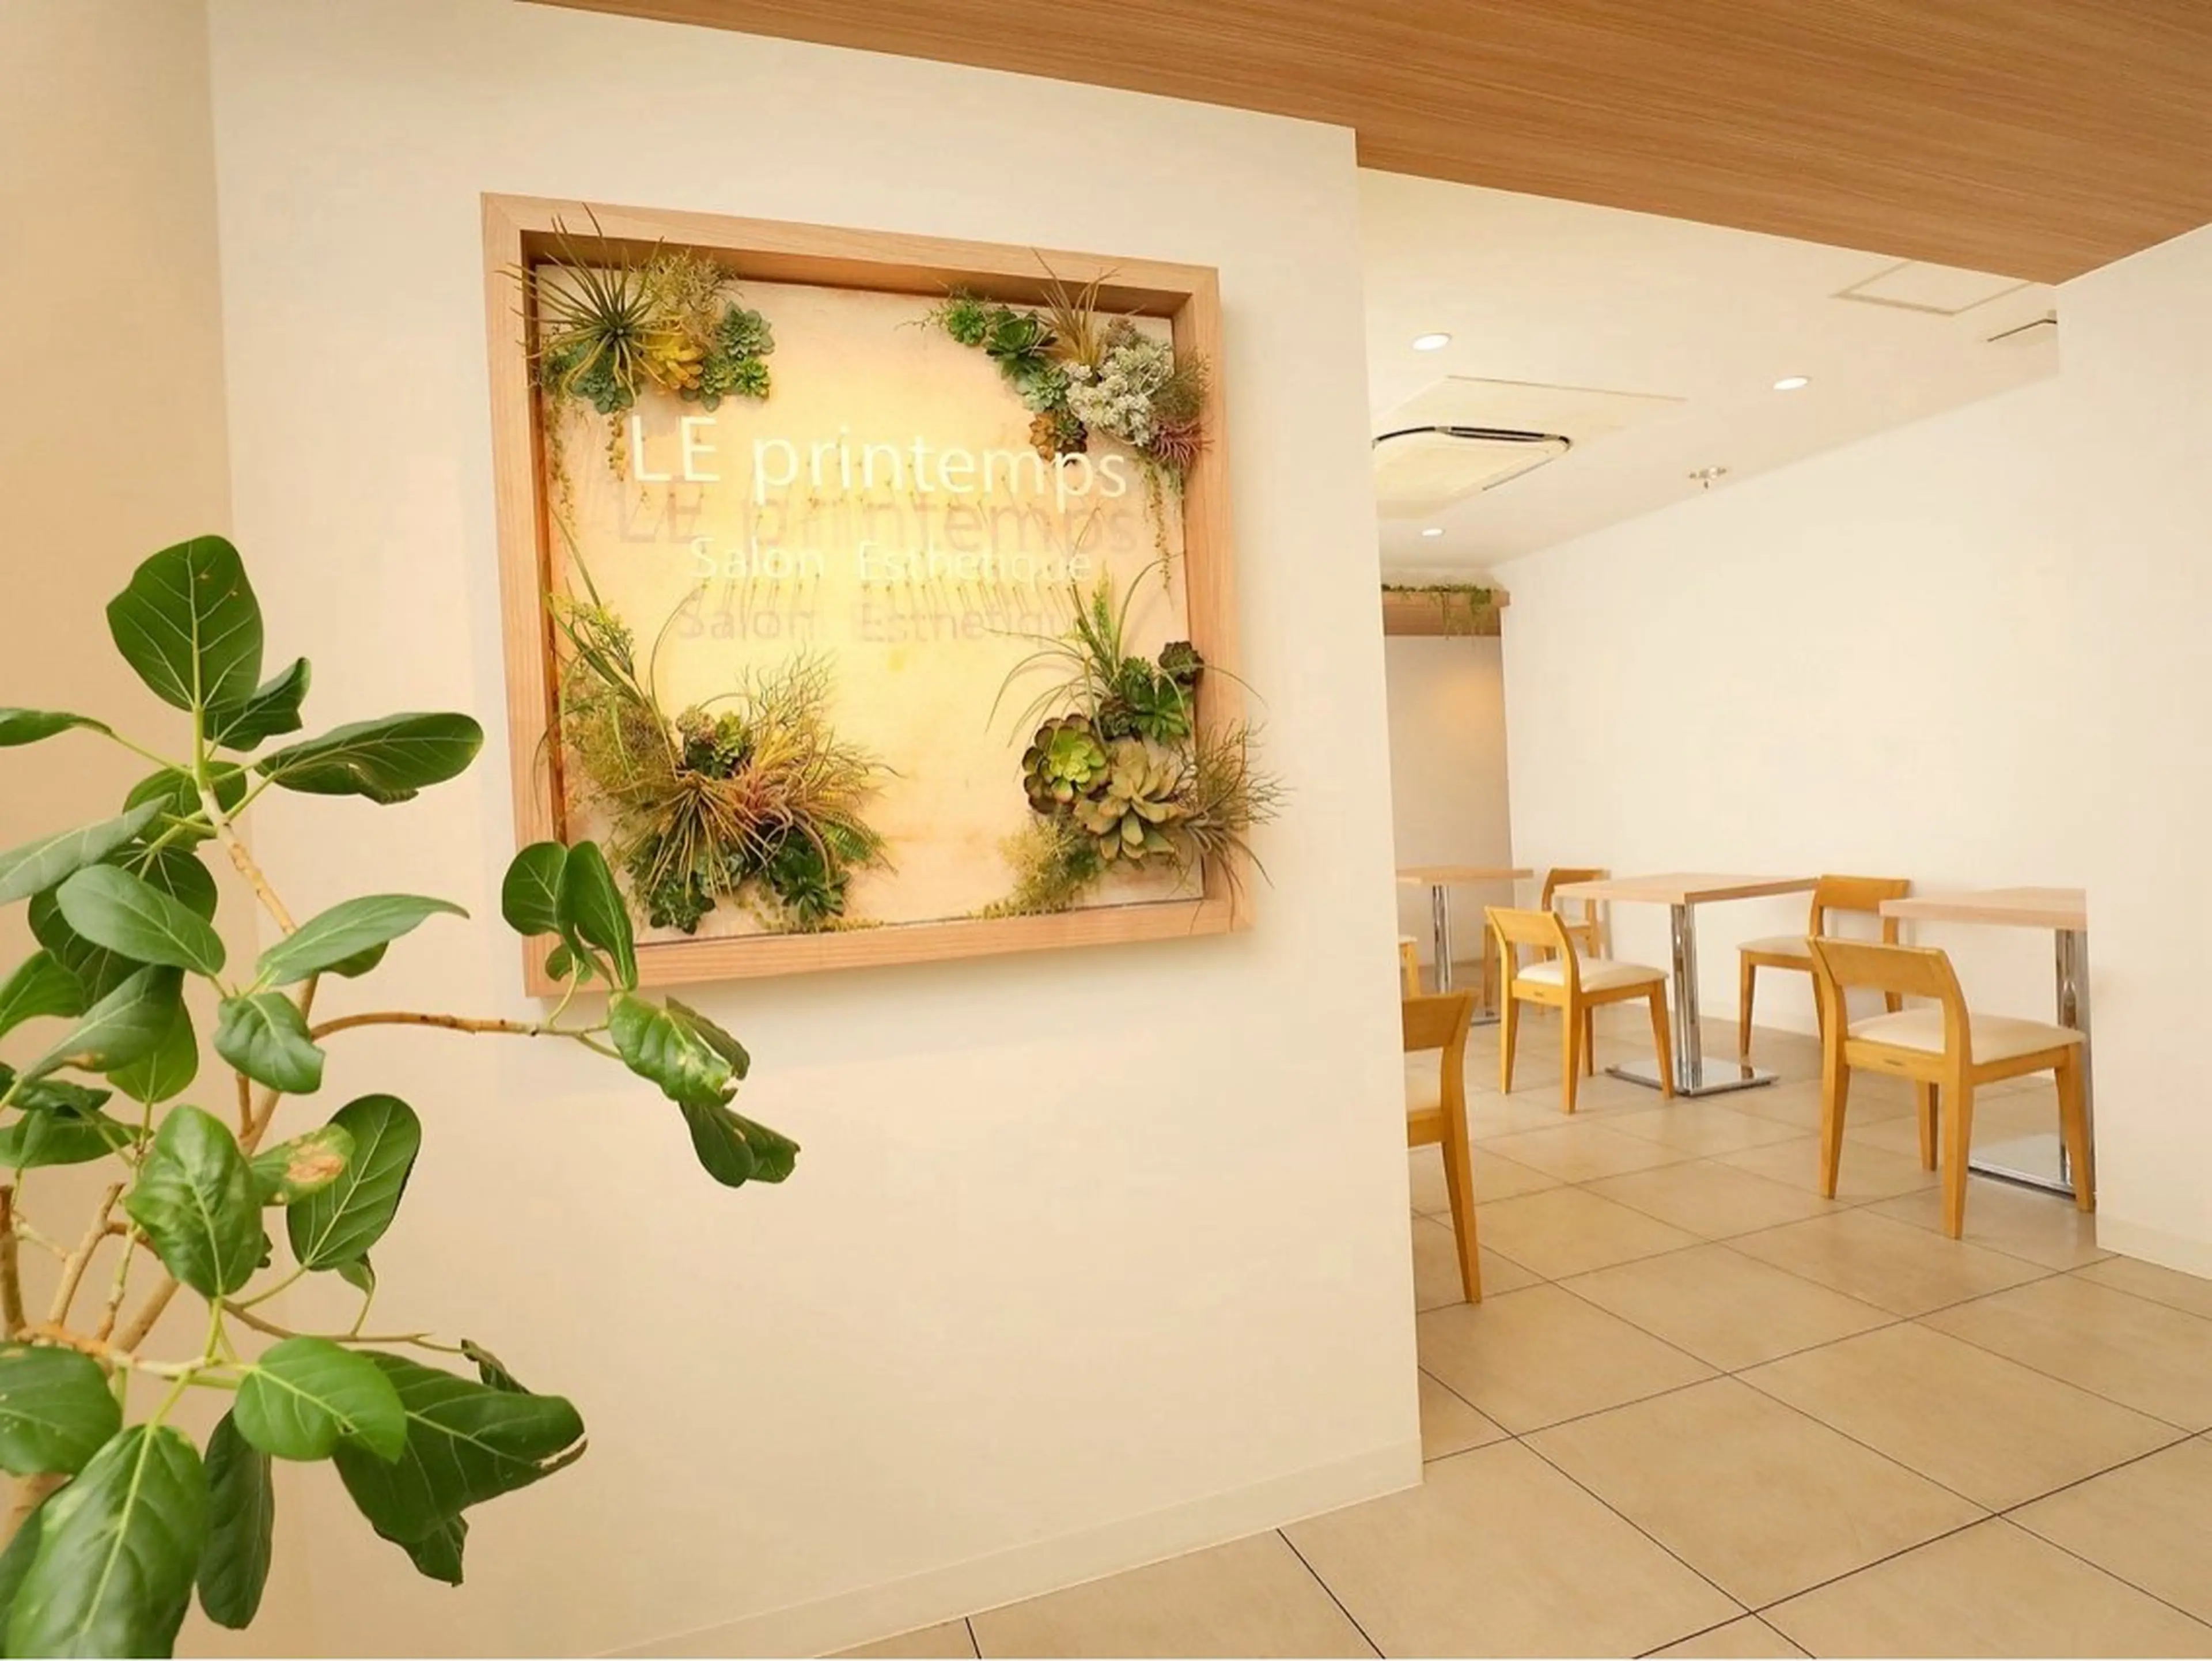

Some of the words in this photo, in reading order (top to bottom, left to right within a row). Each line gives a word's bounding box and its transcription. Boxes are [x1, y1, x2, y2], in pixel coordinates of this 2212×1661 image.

[632, 415, 721, 482] LE
[753, 425, 1127, 513] printemps
[690, 536, 824, 579] Salon
